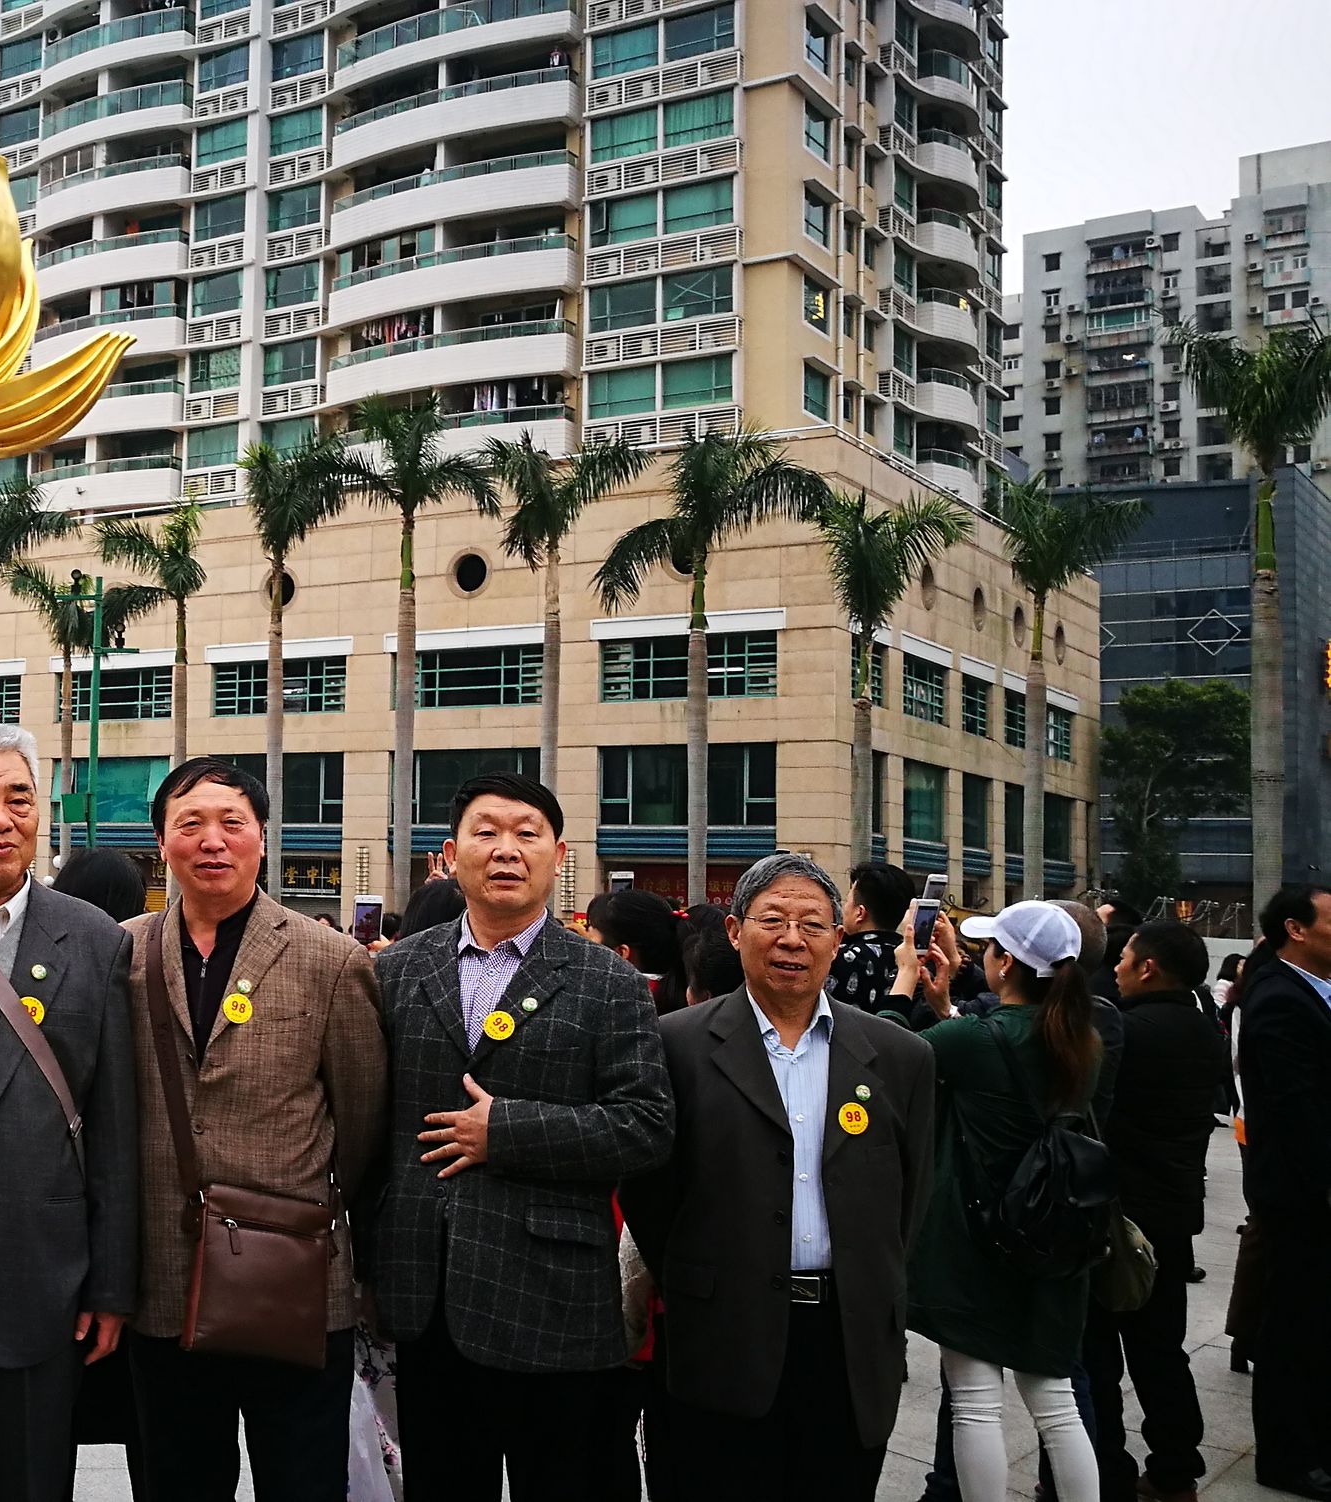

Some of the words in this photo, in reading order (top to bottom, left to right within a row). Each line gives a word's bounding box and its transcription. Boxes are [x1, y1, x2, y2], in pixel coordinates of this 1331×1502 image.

[231, 1000, 246, 1014] 98
[493, 1017, 508, 1032] 98
[845, 1110, 861, 1123] 98
